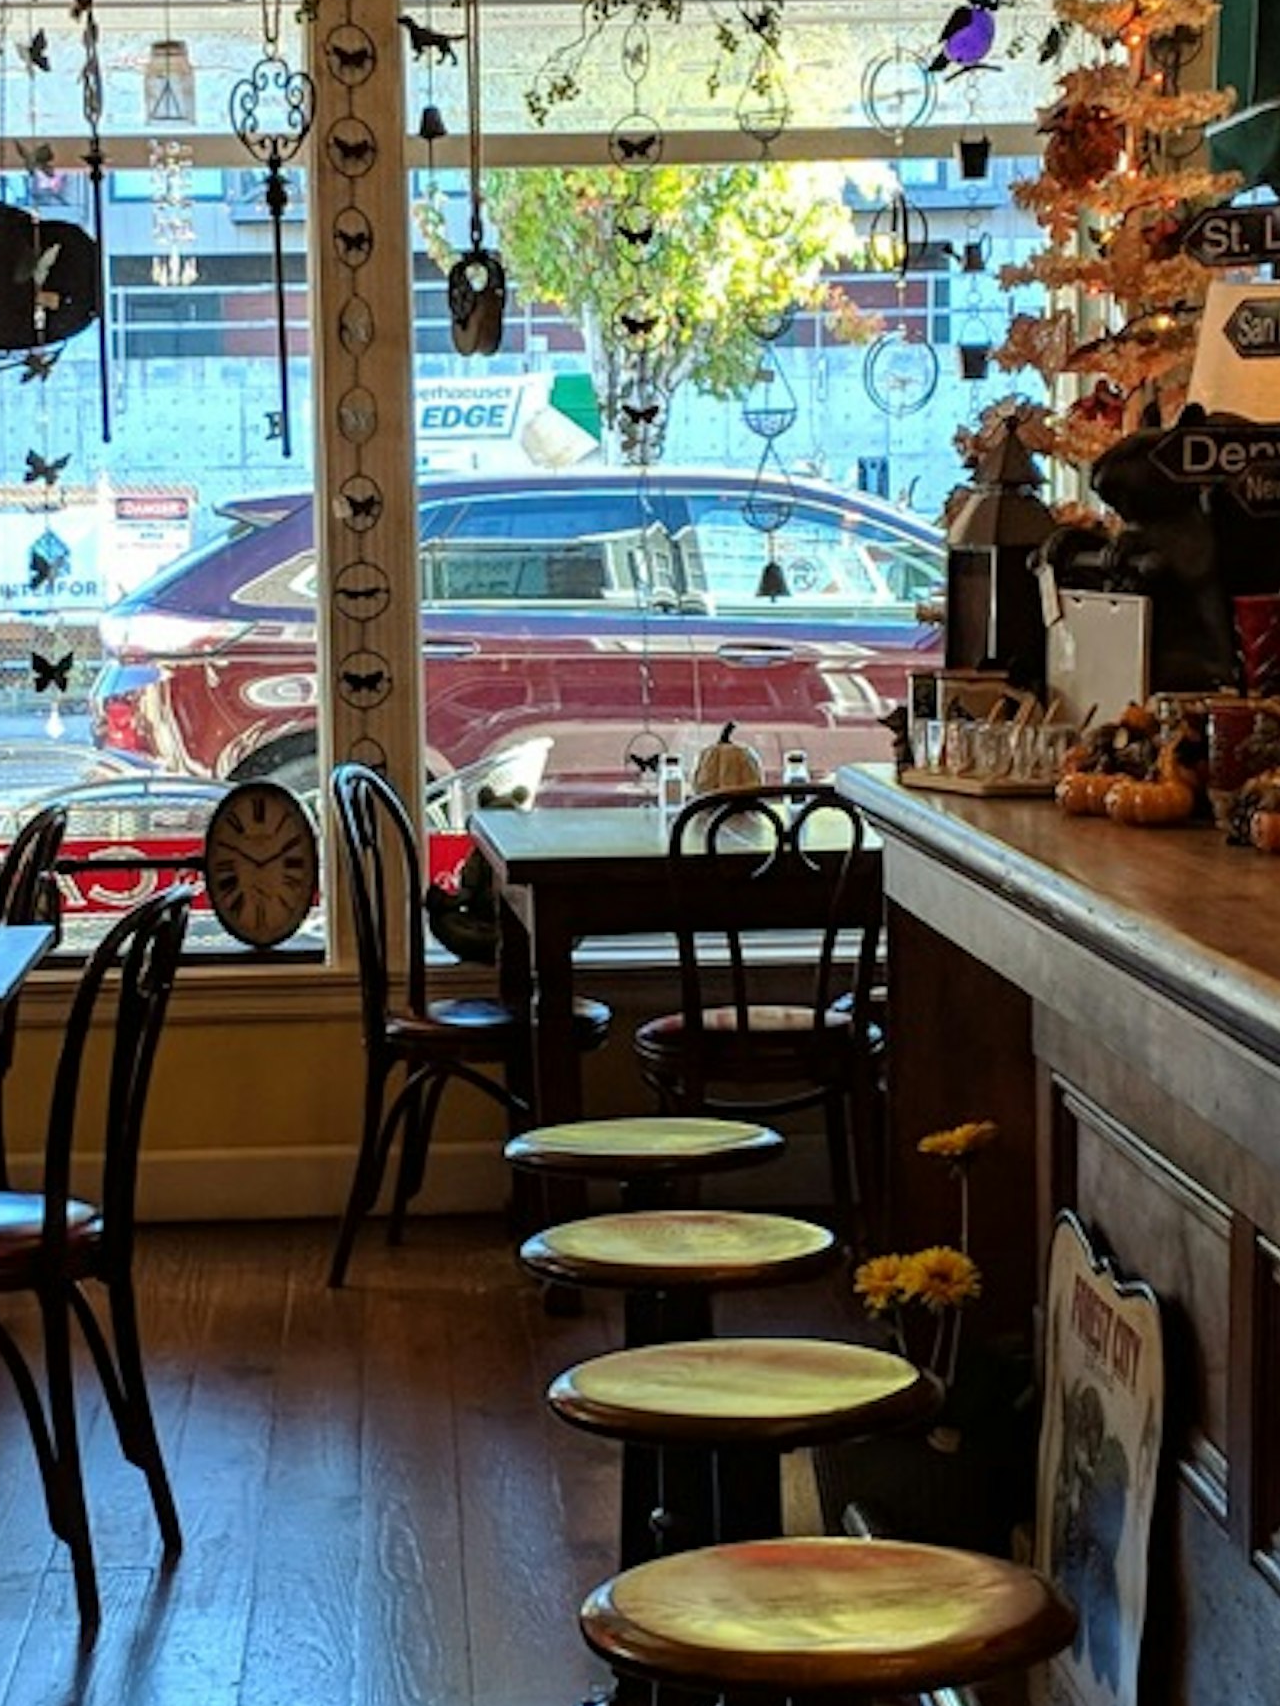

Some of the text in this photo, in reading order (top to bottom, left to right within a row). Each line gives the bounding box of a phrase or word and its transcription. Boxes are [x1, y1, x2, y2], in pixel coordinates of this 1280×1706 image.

[1201, 217, 1251, 255] St.
[1237, 309, 1276, 346] San
[421, 404, 508, 429] EDGE
